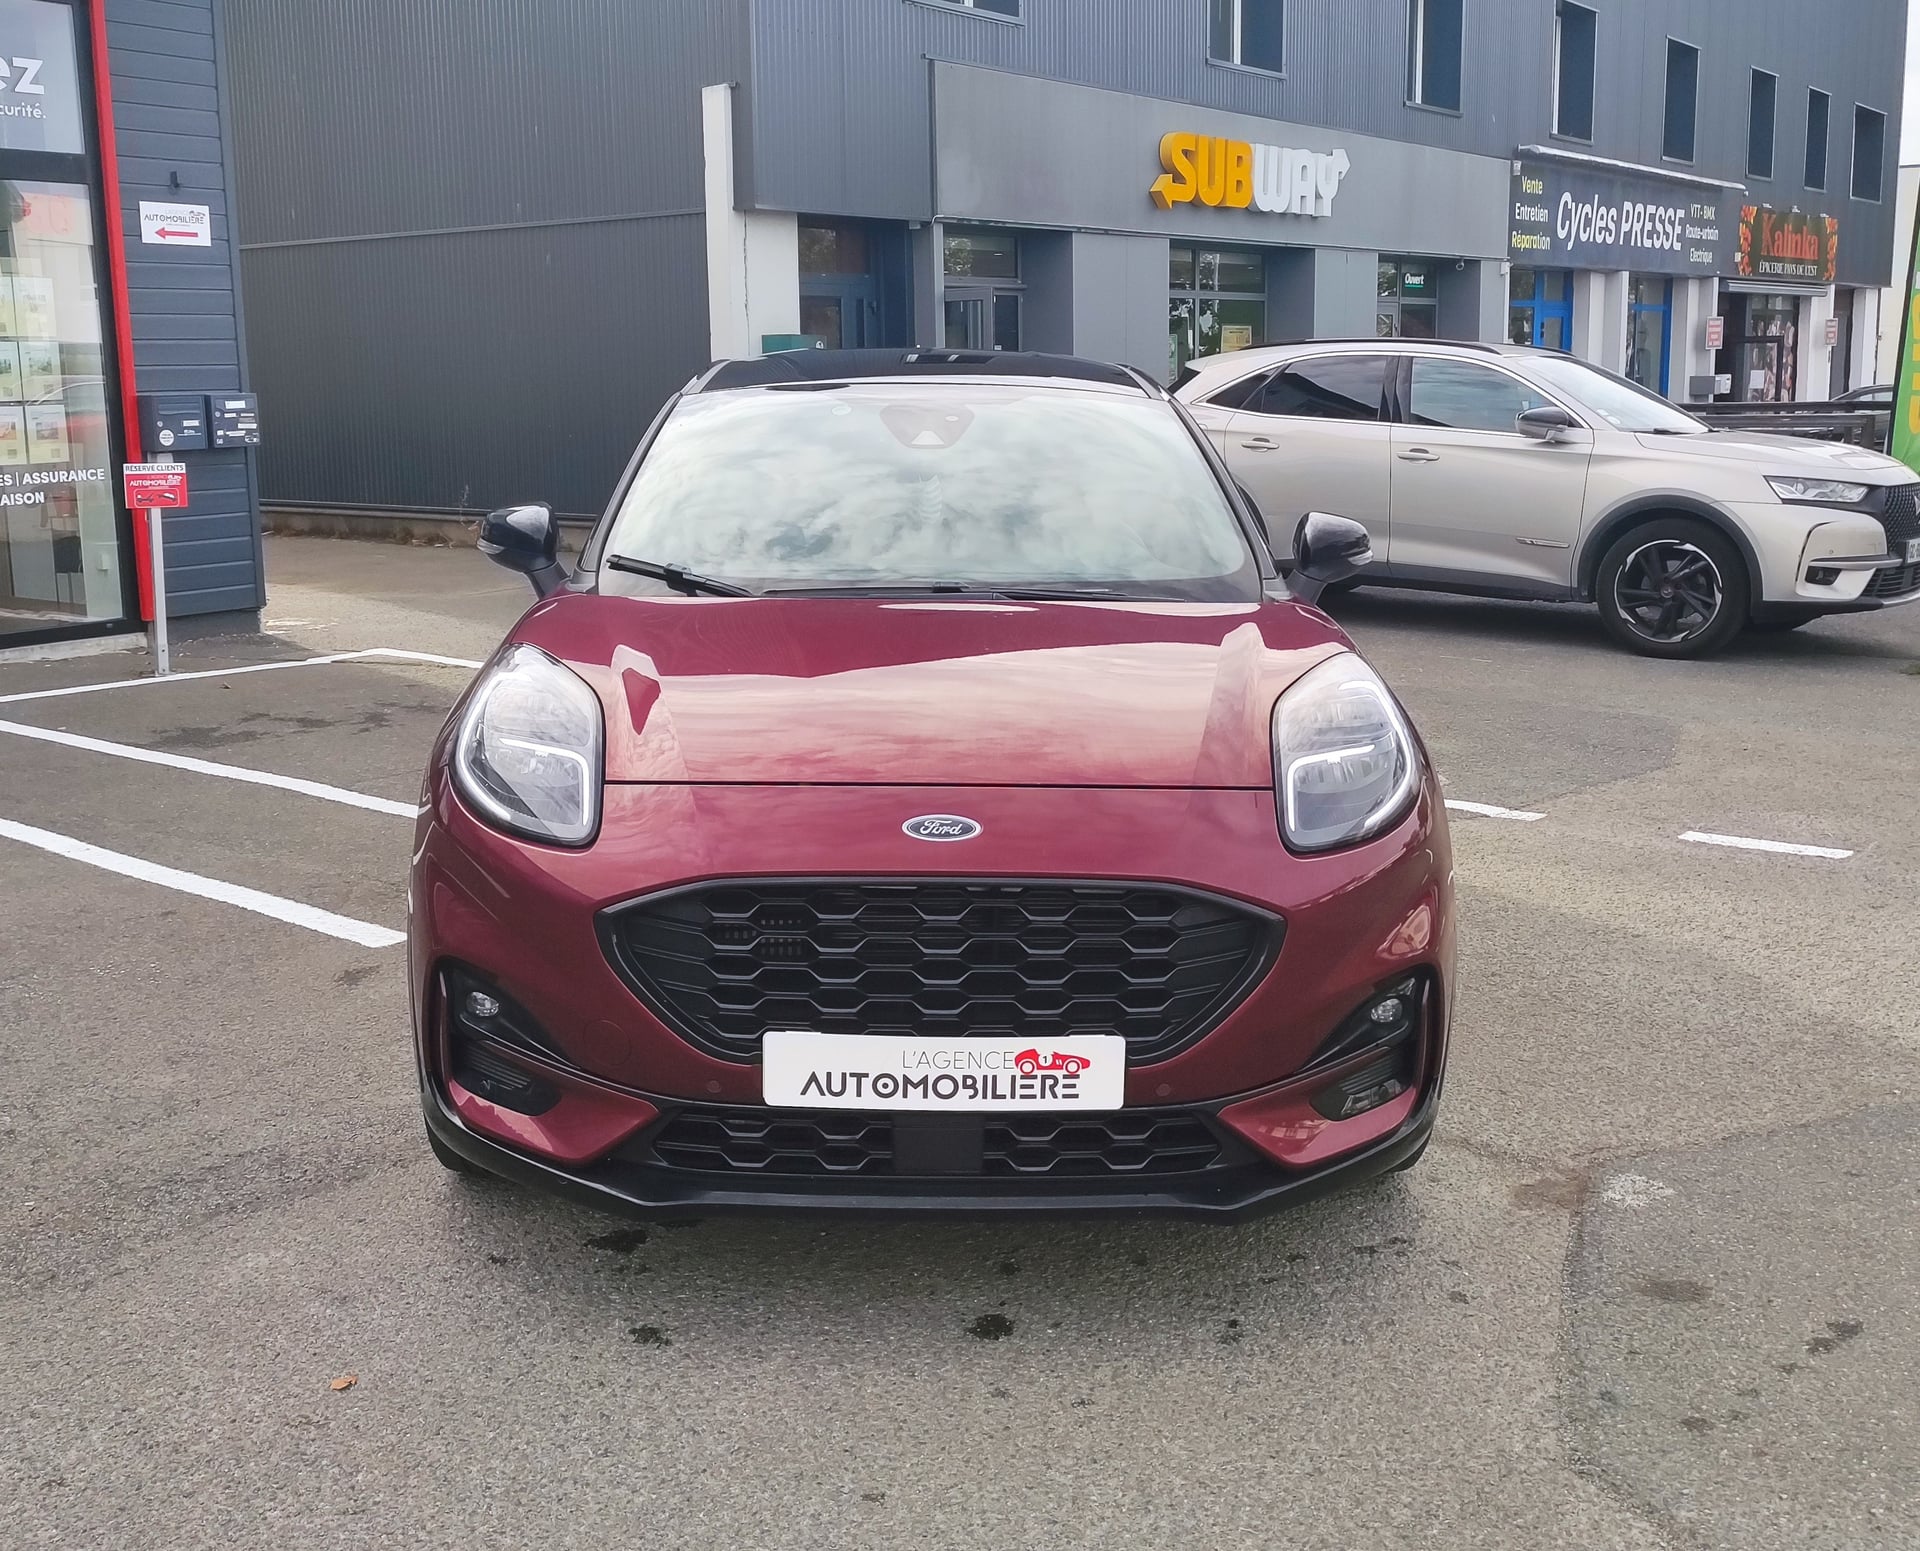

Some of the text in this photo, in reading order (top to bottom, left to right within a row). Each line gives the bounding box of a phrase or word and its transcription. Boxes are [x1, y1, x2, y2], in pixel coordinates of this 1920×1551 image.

[1150, 131, 1350, 217] SUBWAY
[1522, 175, 1543, 195] Vente
[1515, 202, 1548, 222] Entretien
[1557, 191, 1685, 251] Cycles PRESSE
[1511, 230, 1550, 252] Réparation
[1761, 211, 1818, 260] Kalinka
[22, 468, 105, 485] ASSURANCE
[920, 819, 963, 835] Ford
[902, 1051, 1015, 1070] L'AGENCE
